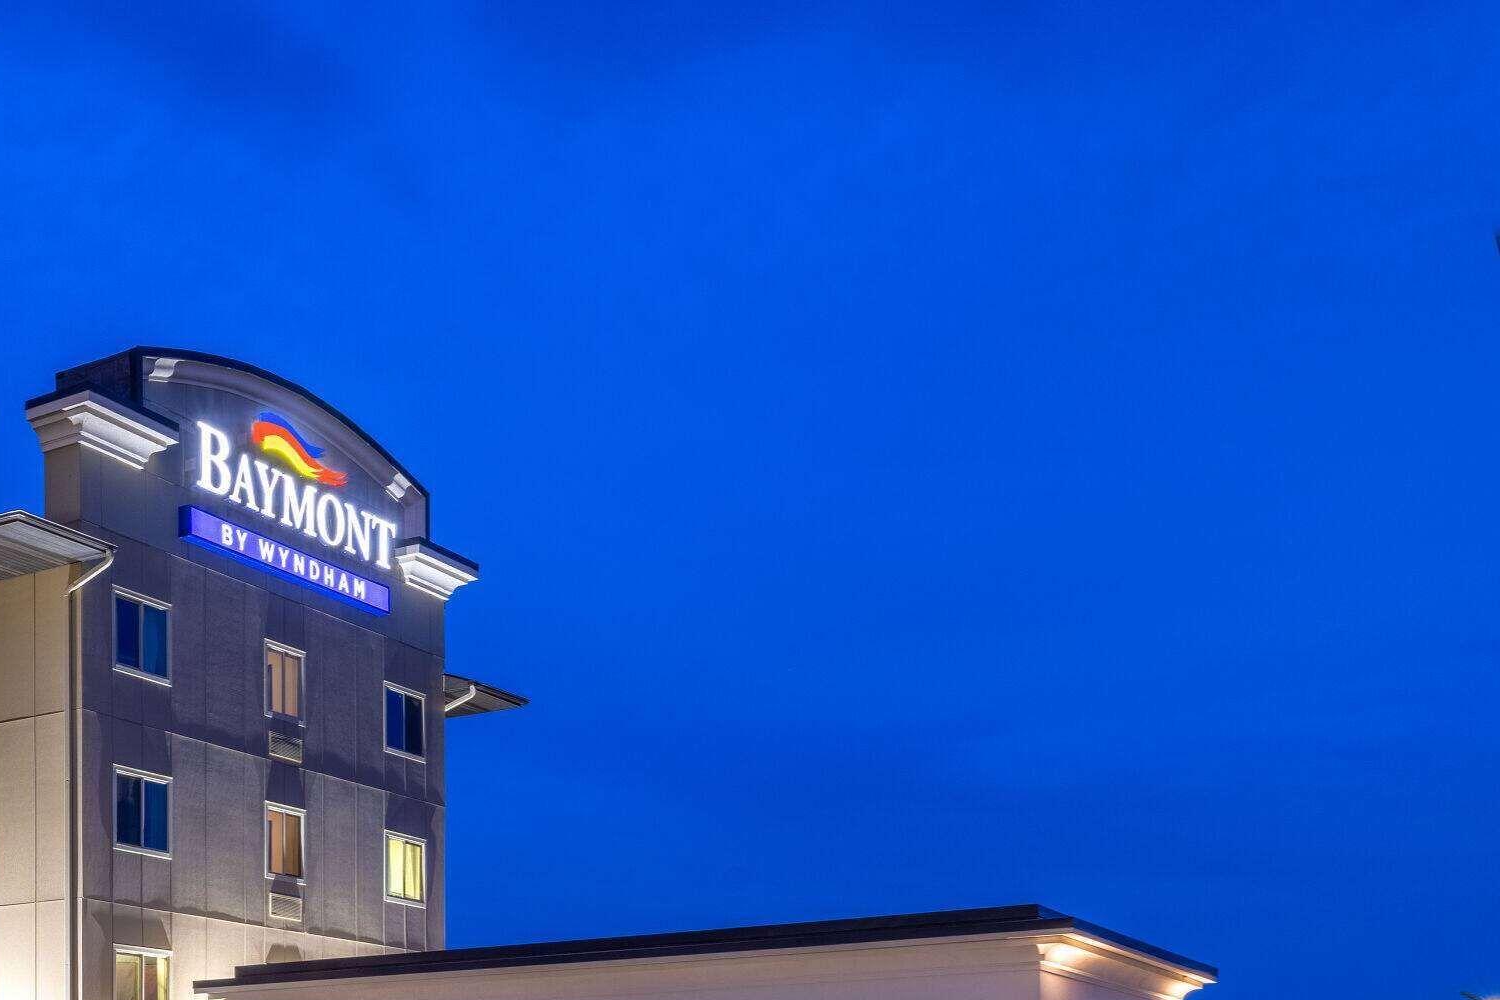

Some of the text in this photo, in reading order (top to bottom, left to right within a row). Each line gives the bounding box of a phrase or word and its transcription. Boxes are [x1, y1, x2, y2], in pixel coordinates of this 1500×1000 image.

[196, 420, 396, 569] BAYMONT
[220, 523, 367, 600] BY WYNDHAM
